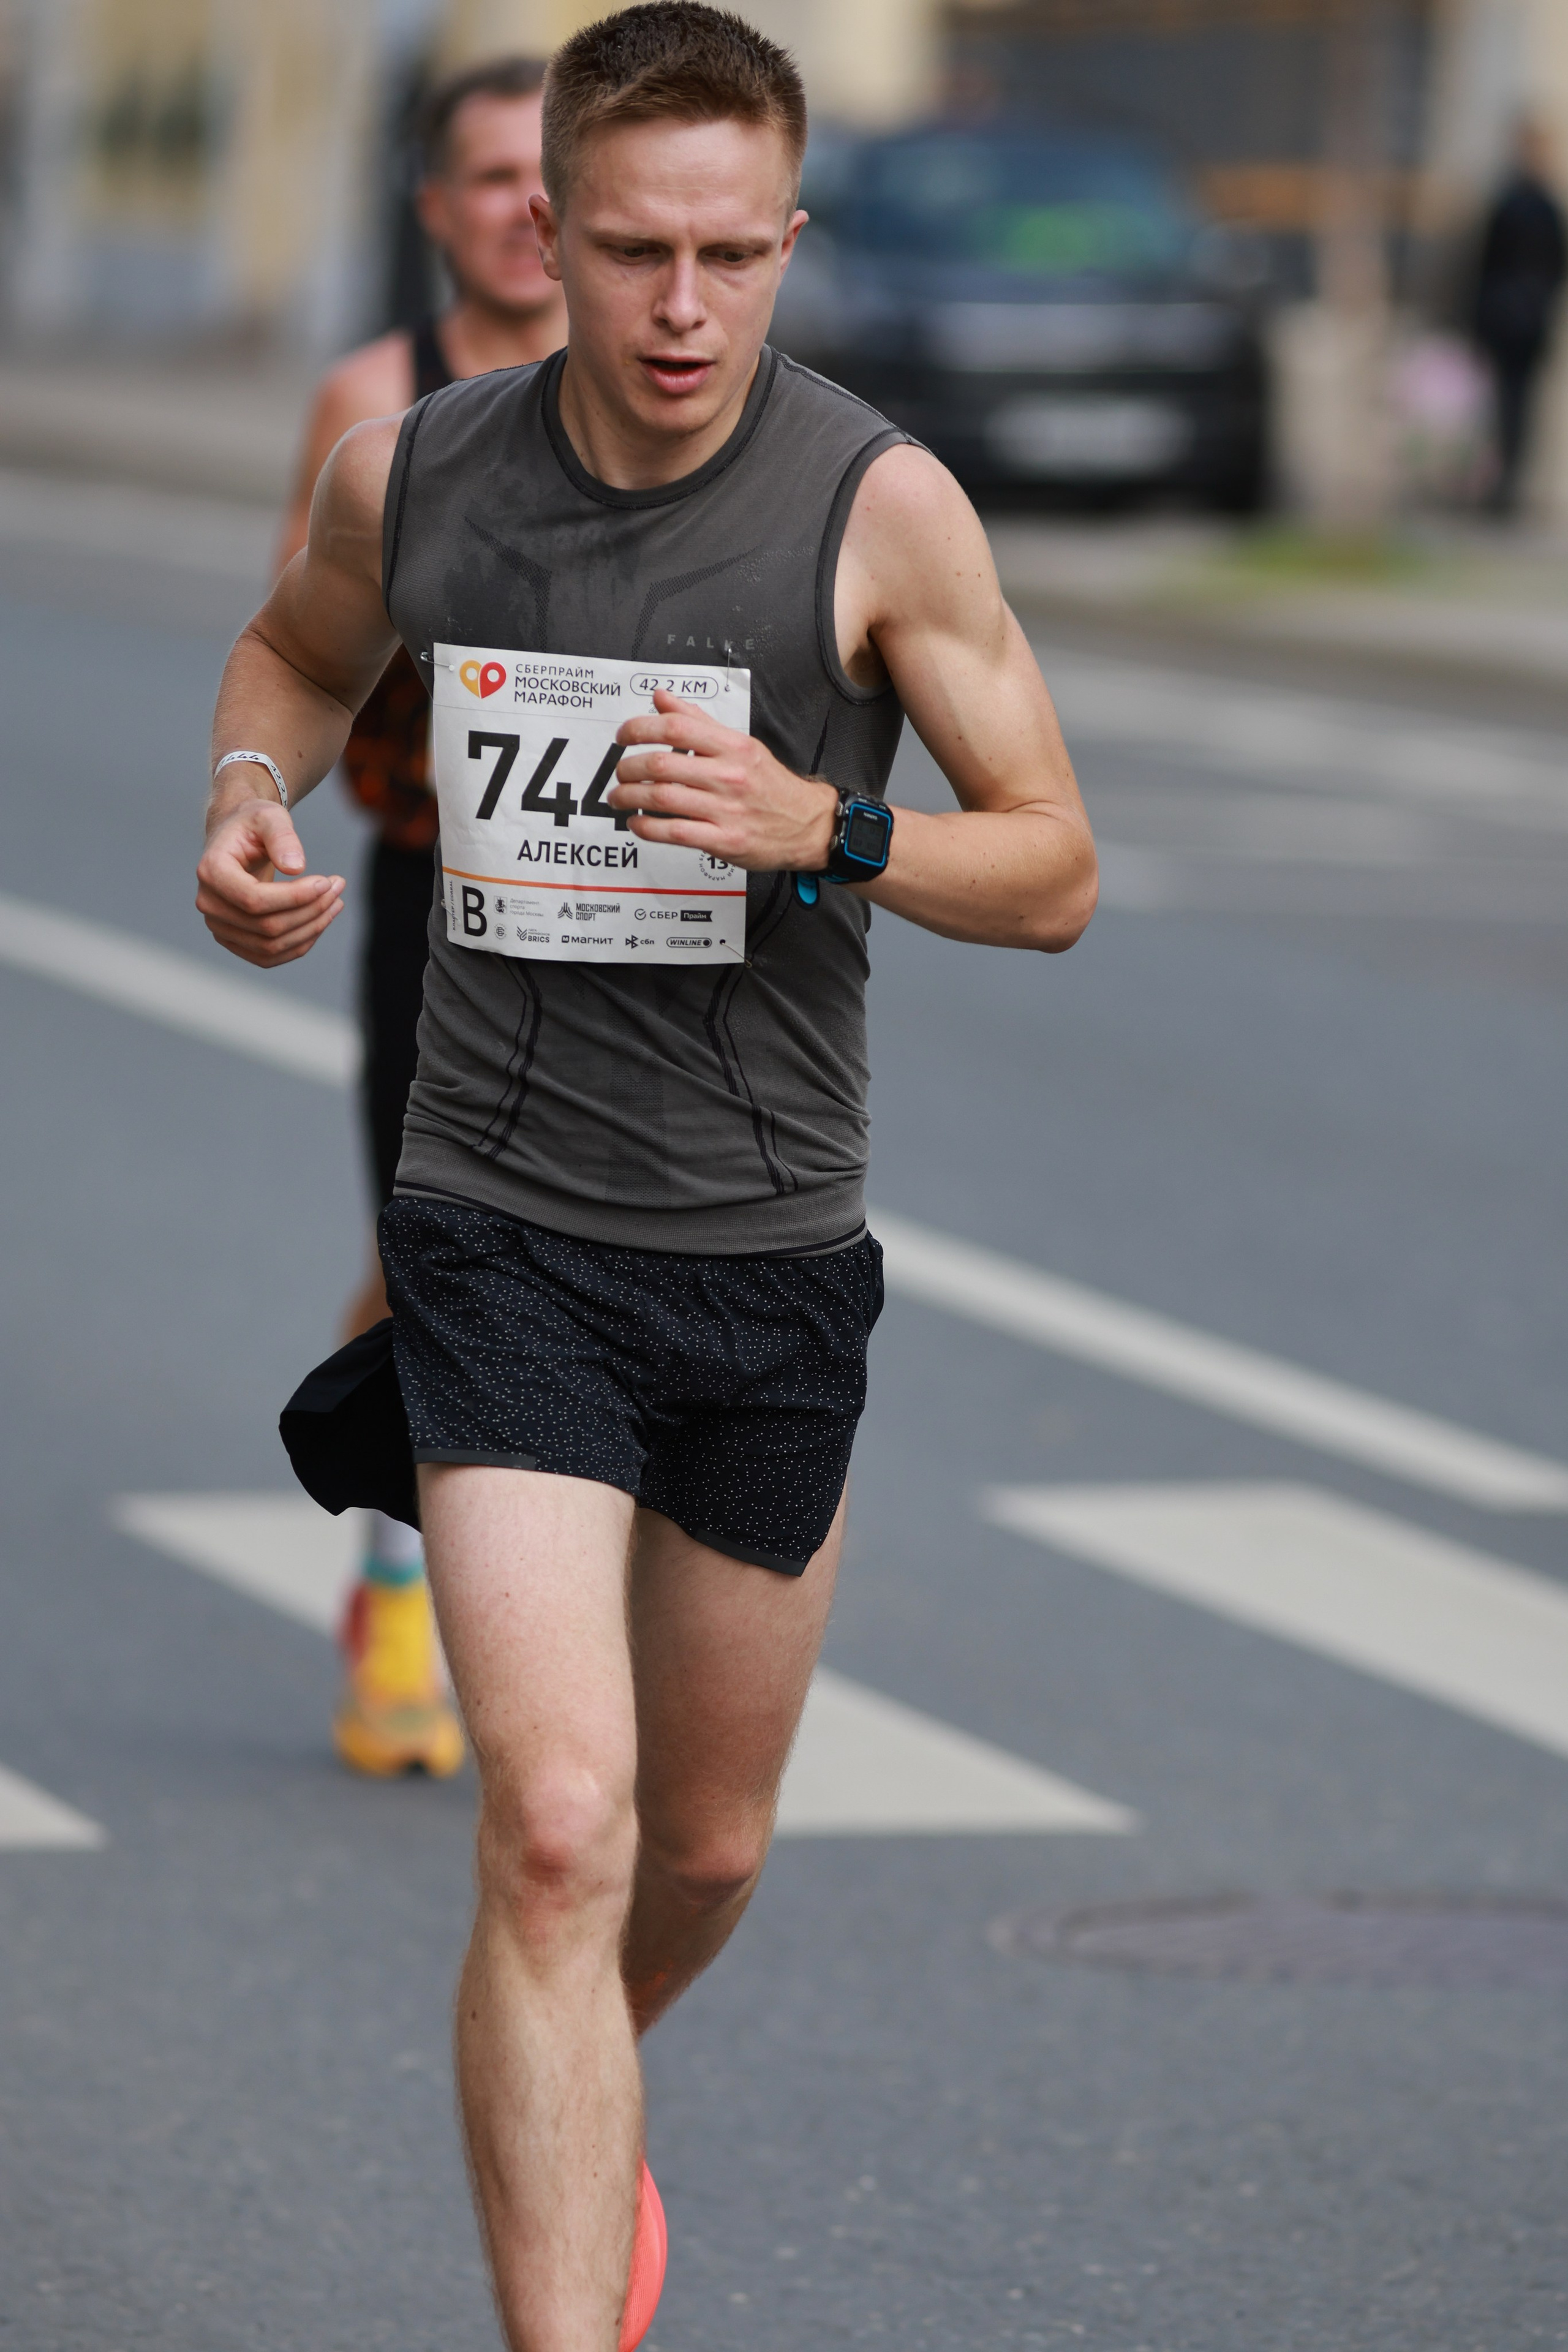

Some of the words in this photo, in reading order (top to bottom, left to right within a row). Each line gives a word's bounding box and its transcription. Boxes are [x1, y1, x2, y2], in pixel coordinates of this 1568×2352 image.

[667, 634, 755, 650] FALKE
[516, 663, 594, 679] СБЕРПРАЙМ
[514, 676, 620, 696] МОСКОВСКИЙ
[639, 678, 674, 692] 422
[514, 691, 593, 708] МАРАФОН
[467, 729, 692, 832] 744
[517, 839, 638, 869] АЛЕКСЕЙ
[576, 902, 620, 913] МОСКОВСКИЙ
[649, 910, 678, 919] СБЕР
[576, 911, 596, 921] СПОРТ
